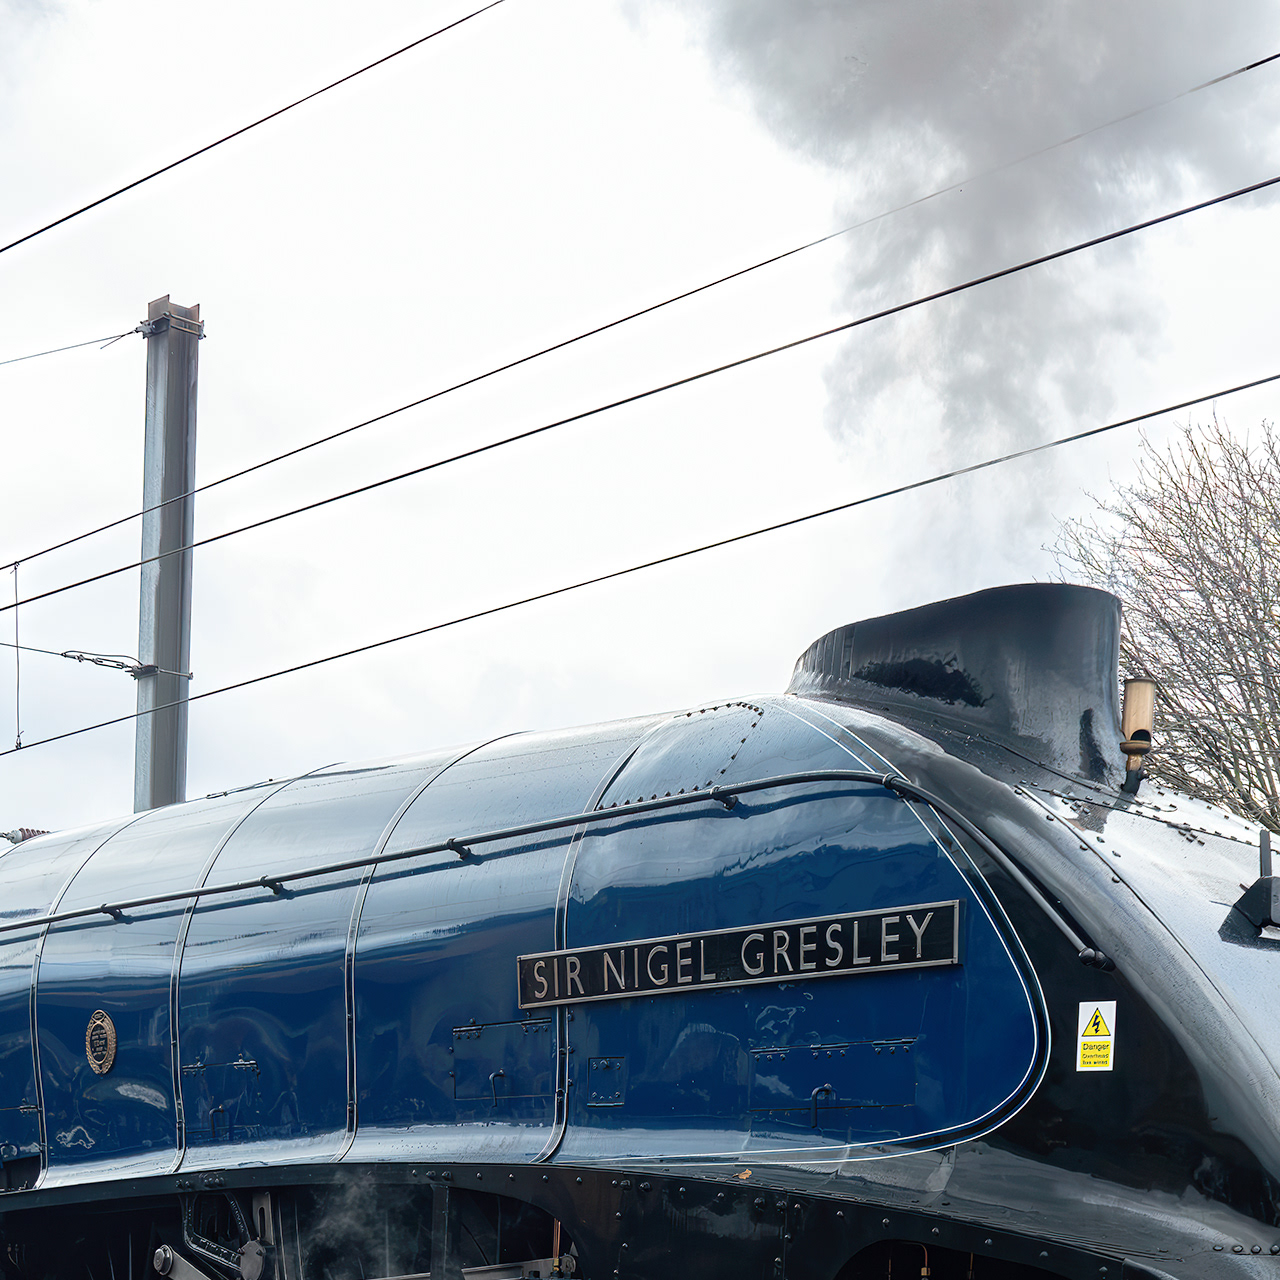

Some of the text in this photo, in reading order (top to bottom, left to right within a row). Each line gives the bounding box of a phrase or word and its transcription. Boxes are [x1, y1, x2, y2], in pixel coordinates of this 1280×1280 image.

[533, 912, 934, 999] SIR NIGEL GRESLEY
[1082, 1043, 1110, 1051] Danger
